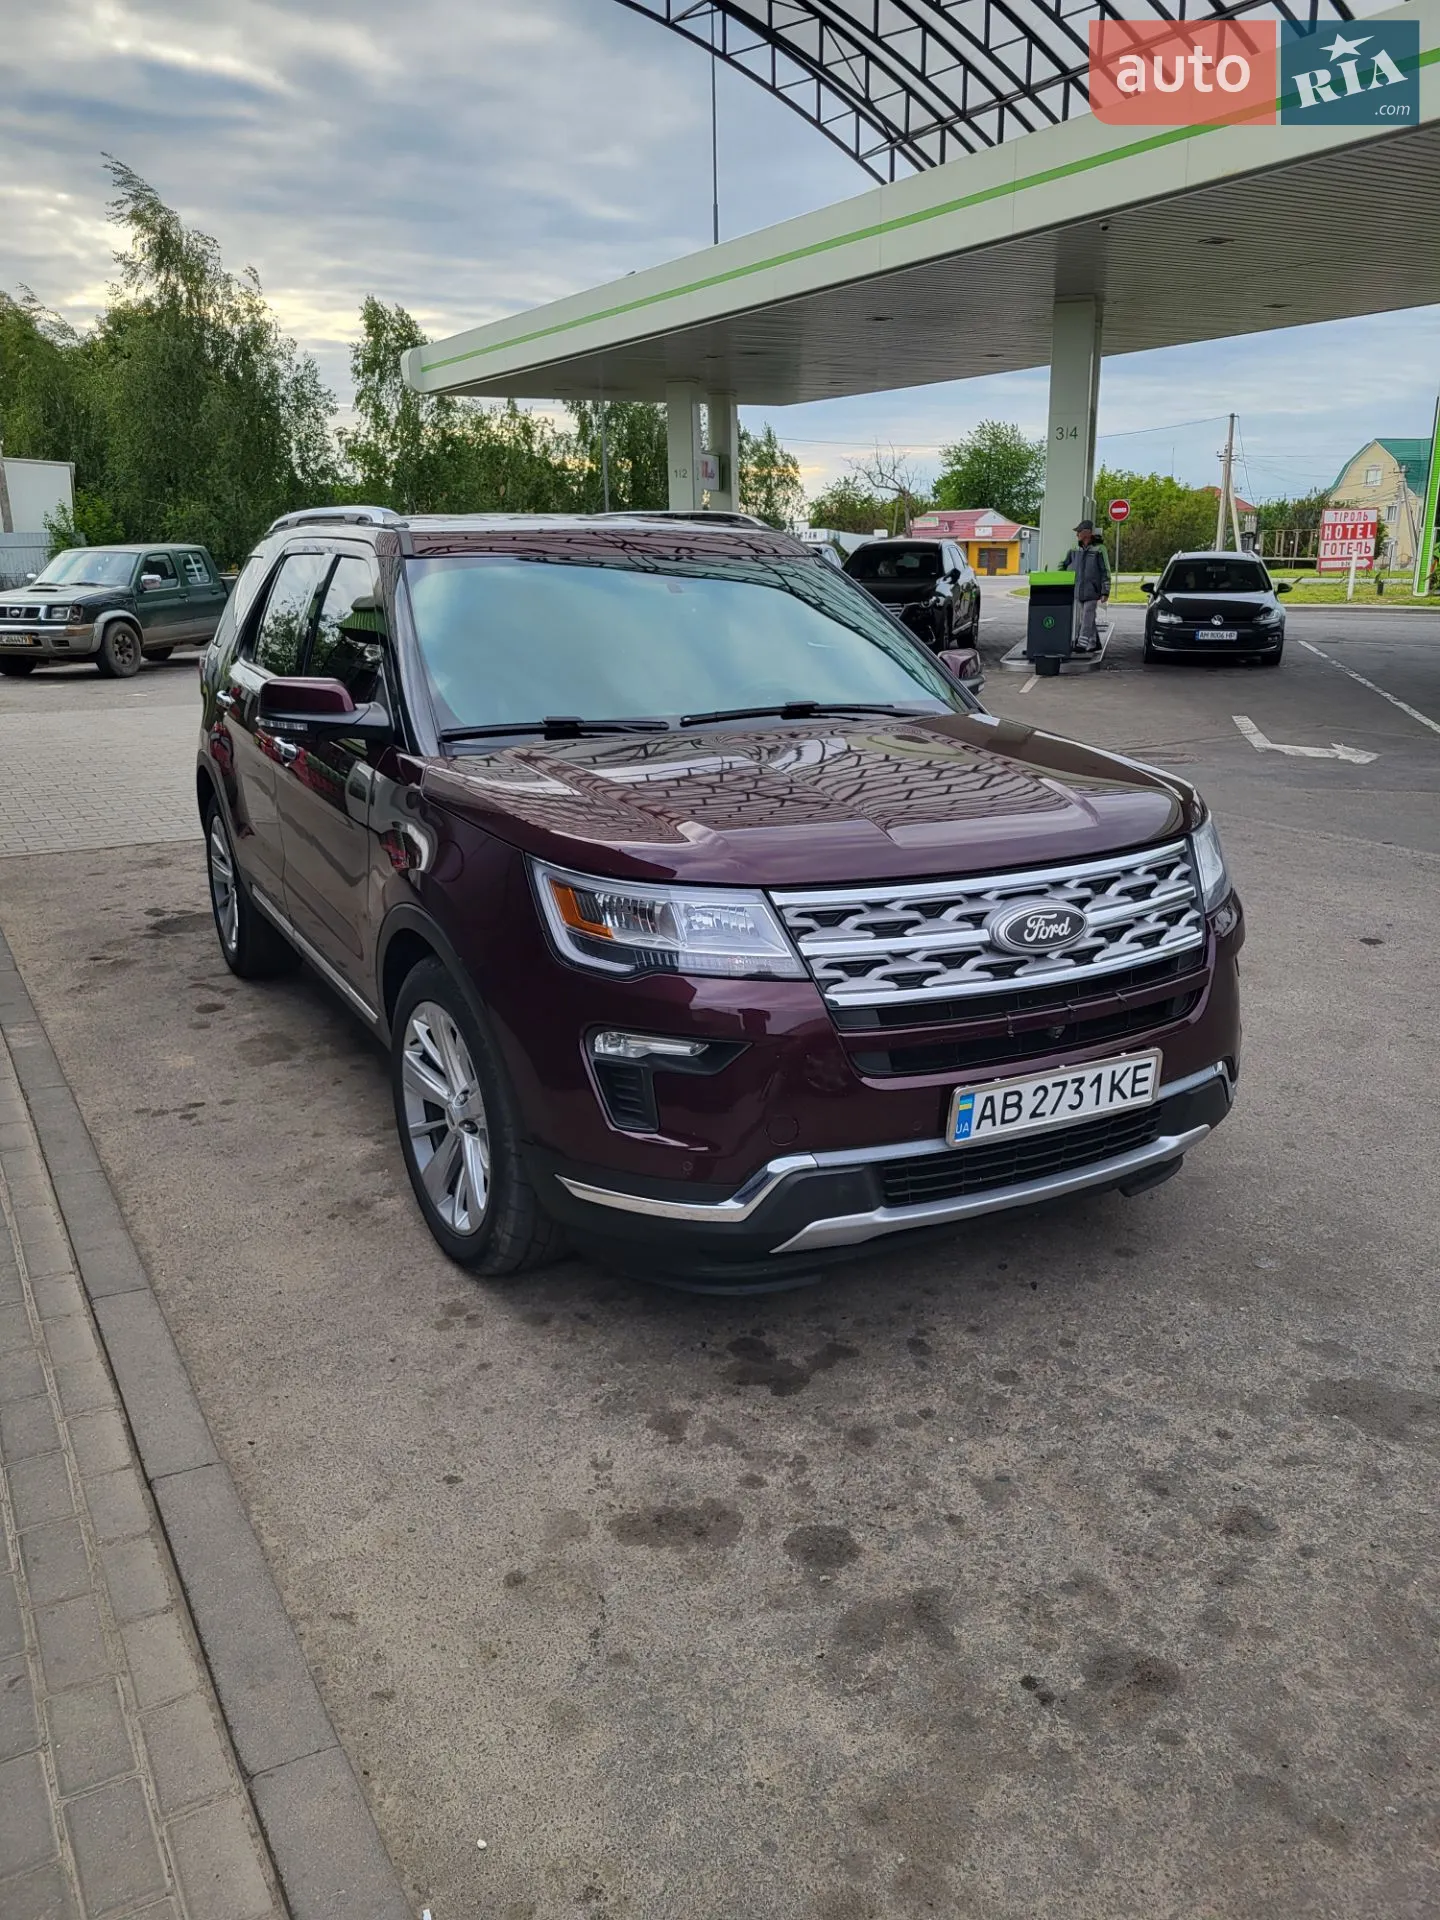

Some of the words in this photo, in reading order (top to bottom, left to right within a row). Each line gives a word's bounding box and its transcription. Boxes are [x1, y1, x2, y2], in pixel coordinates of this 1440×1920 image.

[1334, 511, 1369, 522] ТІРОЛЬ
[1323, 524, 1374, 540] HOTEL
[1322, 541, 1372, 556] ГОТЕЛЬ
[1023, 913, 1072, 942] Ford
[955, 1121, 971, 1135] UA
